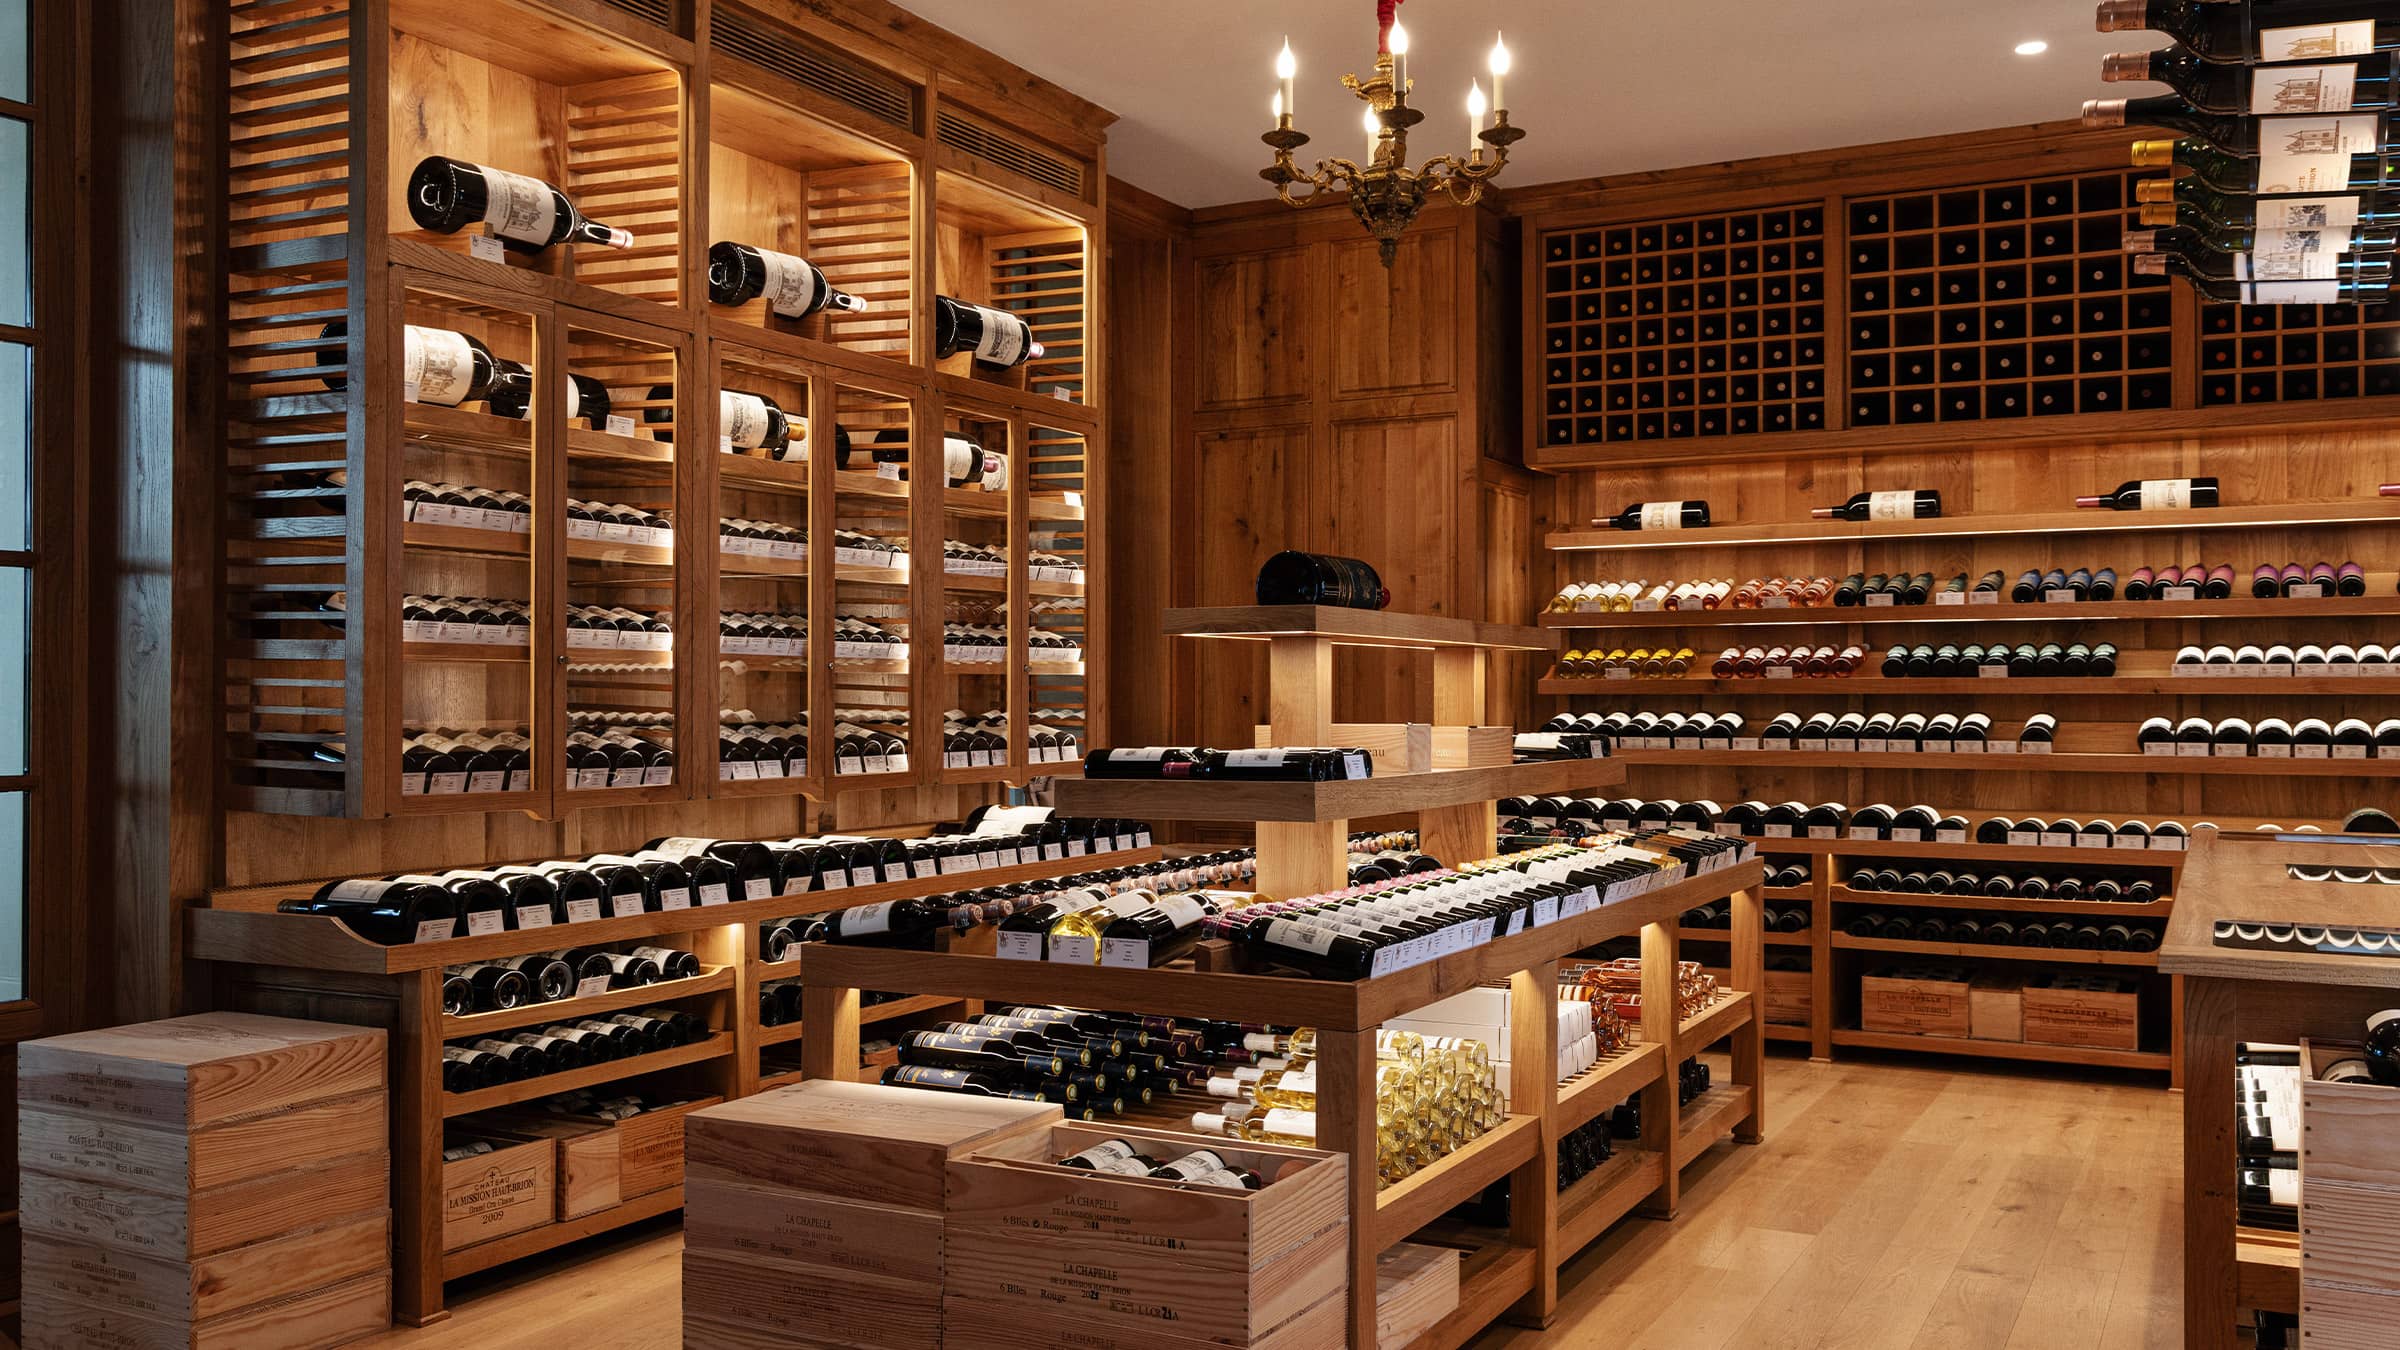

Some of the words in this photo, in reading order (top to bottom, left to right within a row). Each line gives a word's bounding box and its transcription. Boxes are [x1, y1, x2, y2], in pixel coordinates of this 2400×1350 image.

[449, 1199, 459, 1209] LA
[459, 1188, 491, 1207] MISSION
[491, 1177, 534, 1199] HAUT-BRION
[468, 1203, 486, 1215] Grand
[486, 1200, 497, 1210] Cru
[1064, 1194, 1075, 1205] LA
[1075, 1197, 1119, 1211] CHAPELLE
[480, 1210, 504, 1225] 2009
[785, 1213, 796, 1225] LA
[796, 1215, 833, 1230] CHAPELLE
[1095, 1213, 1132, 1225] HAUT-BRION
[1043, 1219, 1070, 1234] Rouge
[1062, 1263, 1074, 1274] LA
[1074, 1264, 1118, 1281] CHAPELLE
[999, 1281, 1006, 1293] 6
[1039, 1287, 1067, 1304] Rouge
